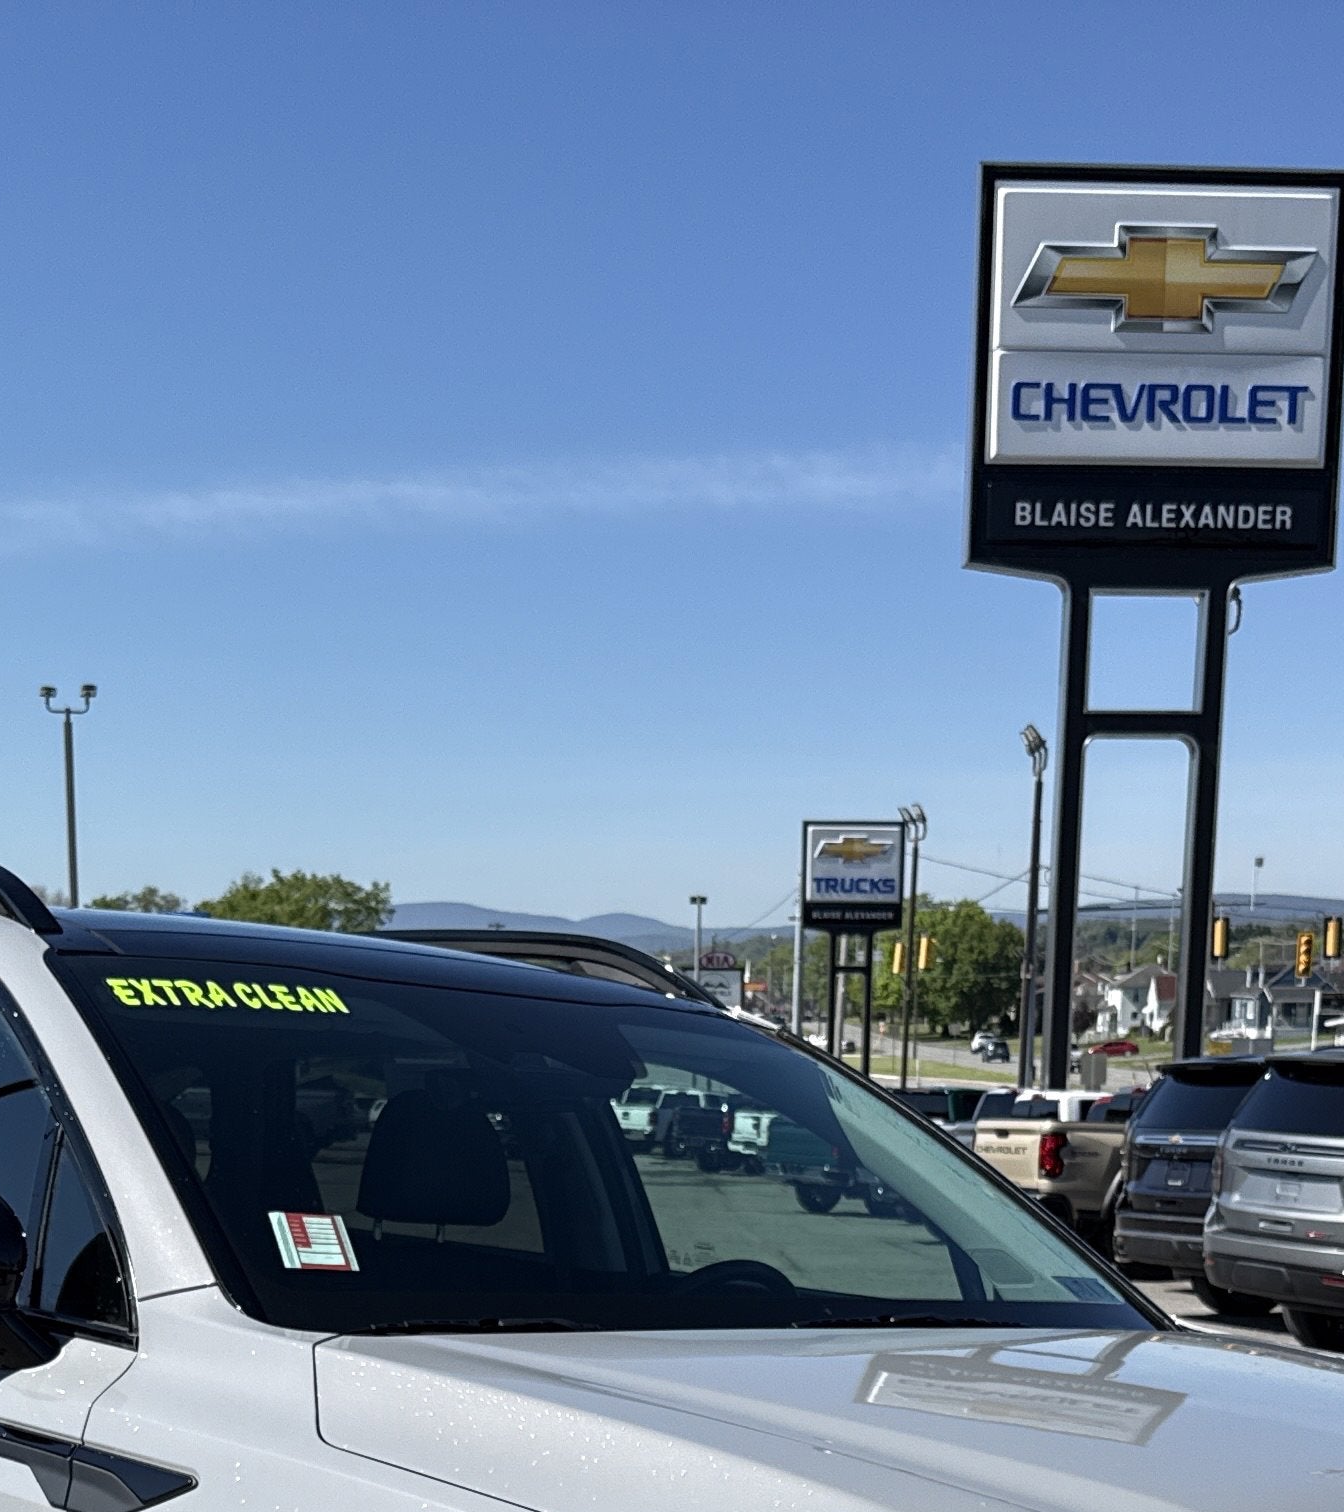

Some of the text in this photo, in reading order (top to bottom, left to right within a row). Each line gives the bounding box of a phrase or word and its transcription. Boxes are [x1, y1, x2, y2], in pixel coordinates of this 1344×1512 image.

[1010, 380, 1311, 426] CHEVROLET
[1013, 500, 1293, 530] BLAISE ALEXANDER
[813, 877, 896, 895] TRUCKS
[105, 977, 351, 1014] EXTRA CLEAN
